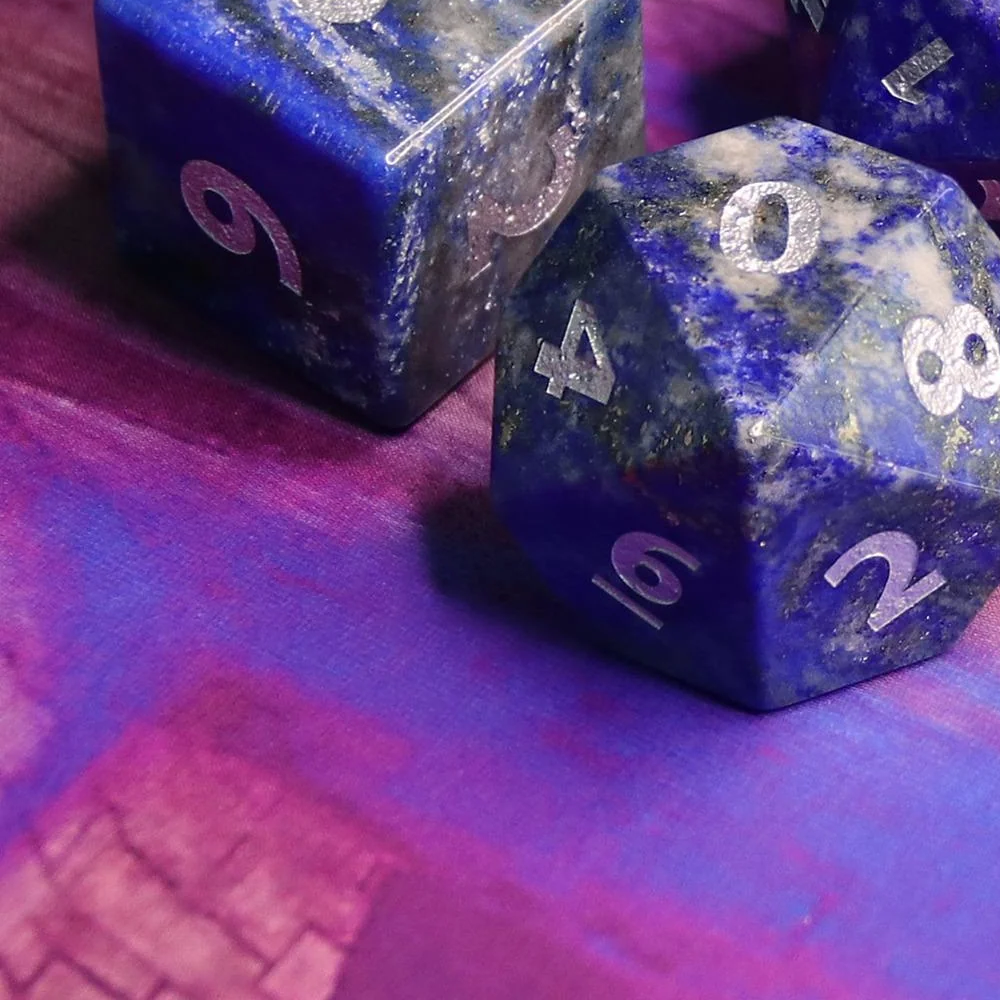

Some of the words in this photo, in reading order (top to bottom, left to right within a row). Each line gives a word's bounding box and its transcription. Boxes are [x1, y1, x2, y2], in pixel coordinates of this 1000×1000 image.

[719, 180, 822, 275] 0
[533, 299, 616, 405] 4
[823, 530, 948, 632] 2
